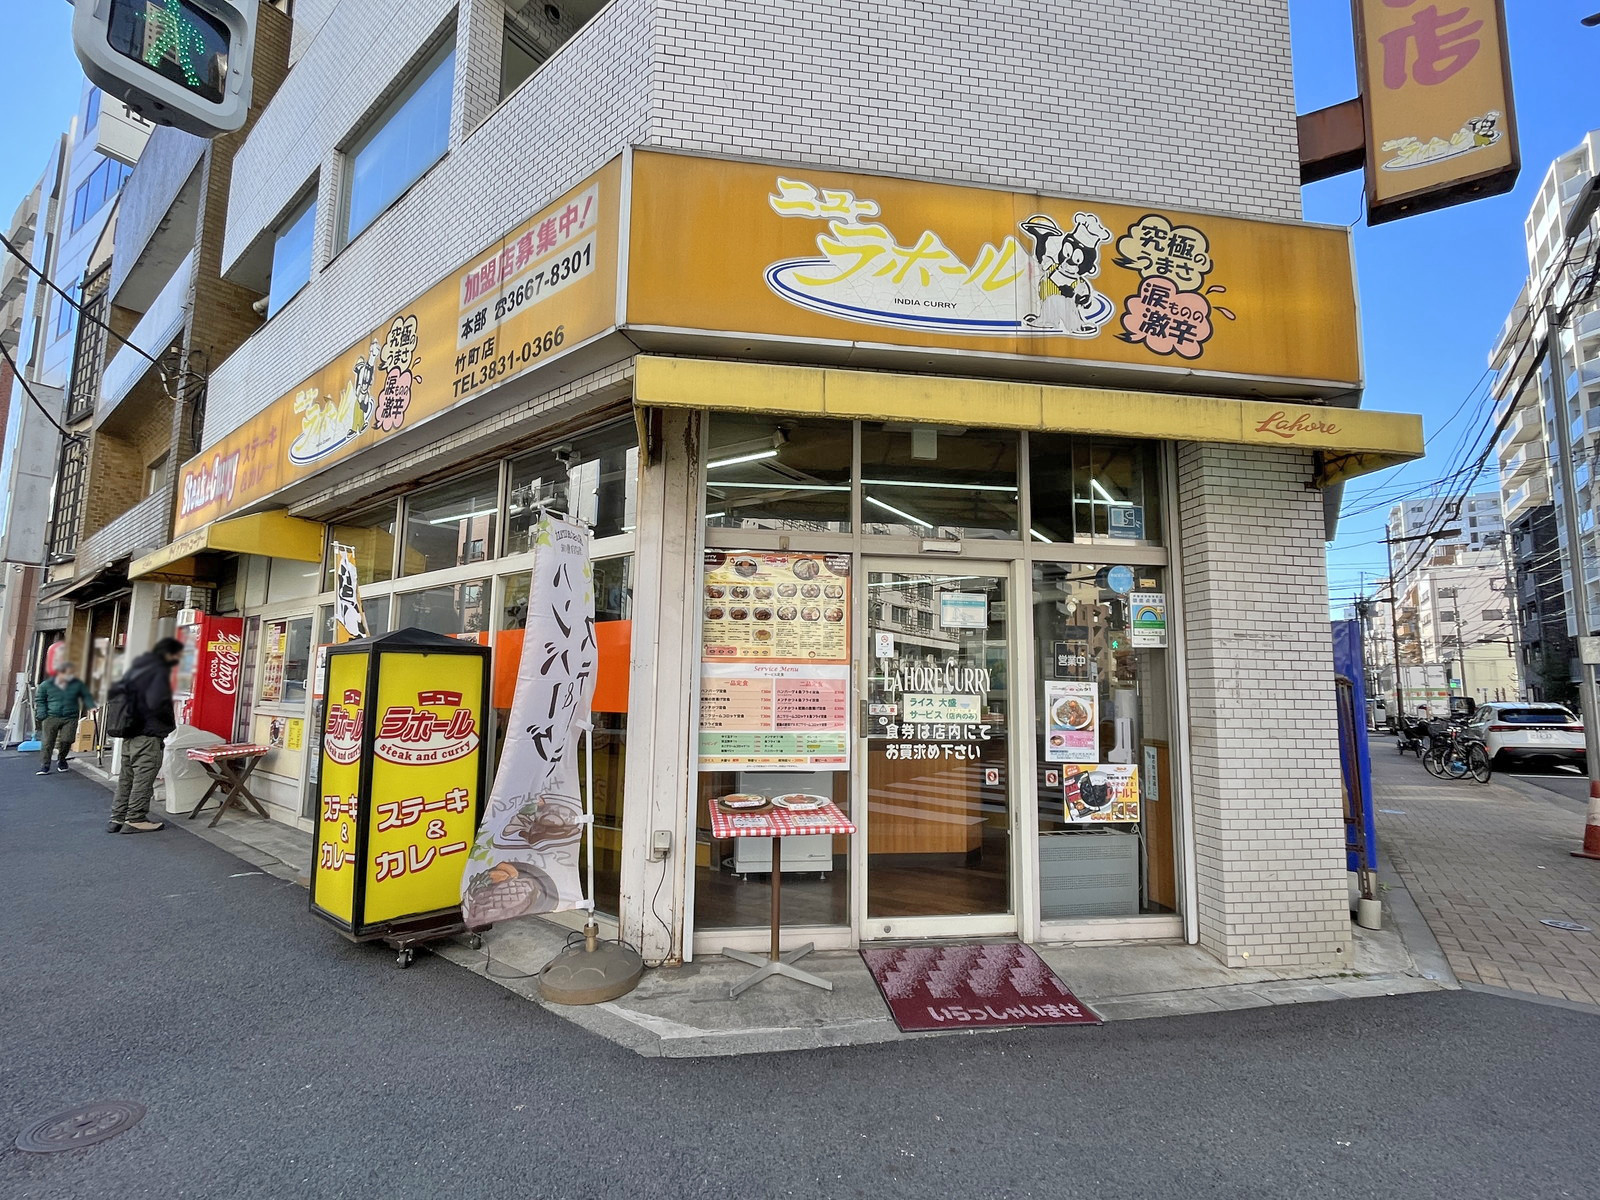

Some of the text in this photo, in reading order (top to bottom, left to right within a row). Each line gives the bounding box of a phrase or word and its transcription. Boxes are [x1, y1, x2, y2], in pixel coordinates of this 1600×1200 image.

[1378, 0, 1484, 90] 店
[771, 179, 880, 216] ニュー
[463, 195, 595, 305] 加盟店募集中!
[793, 224, 1026, 292] ラホール
[1141, 224, 1208, 266] 究極の
[1137, 251, 1195, 281] うまさ
[893, 297, 958, 309] INDIA CURRY
[1141, 281, 1205, 321] 涙ものの
[461, 312, 487, 340] 本部
[1140, 311, 1198, 346] 激辛
[452, 325, 565, 398] TEL3831-0366
[455, 336, 495, 372] 竹町店
[1254, 411, 1342, 439] Lahore
[883, 658, 992, 694] LAHORE CURRY
[344, 691, 360, 705] ニュー
[421, 692, 459, 705] ニュー
[909, 697, 957, 707] ライス 大盛
[327, 704, 363, 741] ラホール
[380, 707, 475, 742] ラホール
[909, 709, 943, 720] サービス
[885, 723, 991, 740] 食券は店内にて
[380, 740, 471, 761] steak and curry
[885, 743, 981, 760] お買求め下さい
[324, 794, 358, 823] ステーキ
[377, 788, 468, 832] ステーキ
[340, 822, 348, 842] &
[426, 819, 447, 840] &
[321, 842, 355, 871] カレー
[375, 841, 467, 883] カレー
[927, 1003, 1082, 1021] いらっしゃいませ
